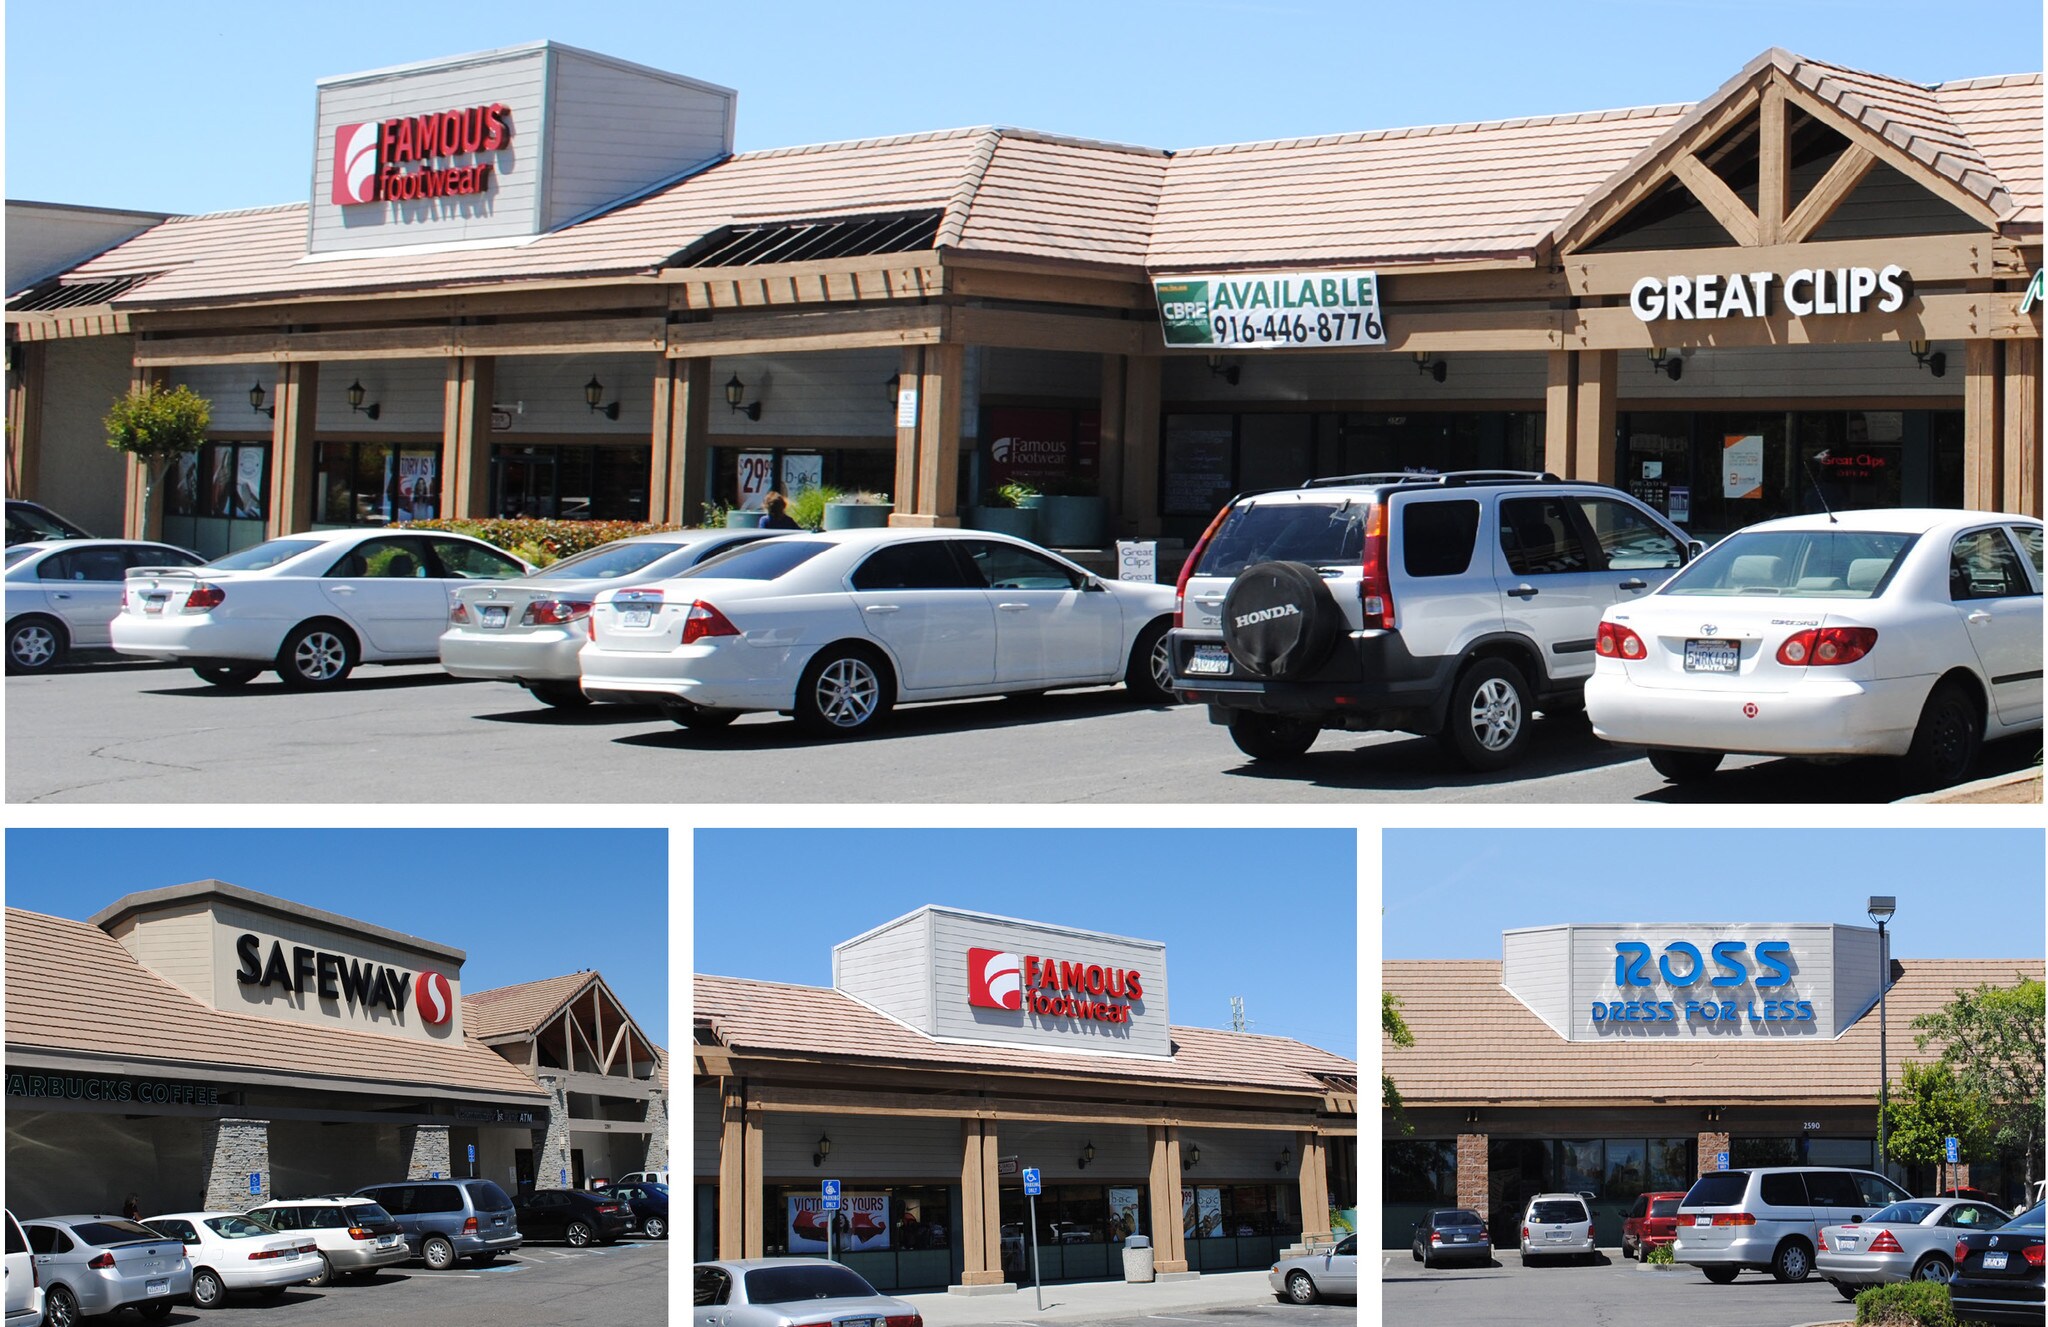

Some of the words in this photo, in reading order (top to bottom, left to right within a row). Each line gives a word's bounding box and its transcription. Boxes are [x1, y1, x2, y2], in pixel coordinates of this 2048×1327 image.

[381, 103, 508, 163] FAMOUS
[380, 163, 489, 200] footwear
[1213, 278, 1373, 310] AVAILABLE
[1630, 271, 1773, 322] GREAT
[1784, 264, 1903, 316] CLIPS
[1163, 302, 1207, 319] CBRE
[1214, 313, 1381, 343] 916-446-8776
[1012, 437, 1067, 452] Famous
[1012, 451, 1066, 464] Footwear
[1121, 547, 1153, 556] Great
[1123, 556, 1151, 568] Clips
[1120, 571, 1153, 580] Great
[1235, 603, 1299, 628] HONDA
[1687, 650, 1736, 666] 5WRK403
[236, 933, 411, 1012] SAFEWAY
[1615, 941, 1791, 987] ROSS
[1024, 955, 1143, 1000] FAMOUS
[1025, 988, 1132, 1023] footwear
[1591, 1001, 1675, 1022] DRESS
[1685, 1001, 1737, 1022] FOR
[1748, 1001, 1813, 1022] LESS
[5, 1074, 131, 1102] ARBUCKS
[137, 1082, 218, 1106] COFFEE
[519, 1113, 533, 1123] ATM
[1803, 1122, 1820, 1130] 2590
[794, 1197, 822, 1211] VICTO
[851, 1197, 884, 1211] YOURS
